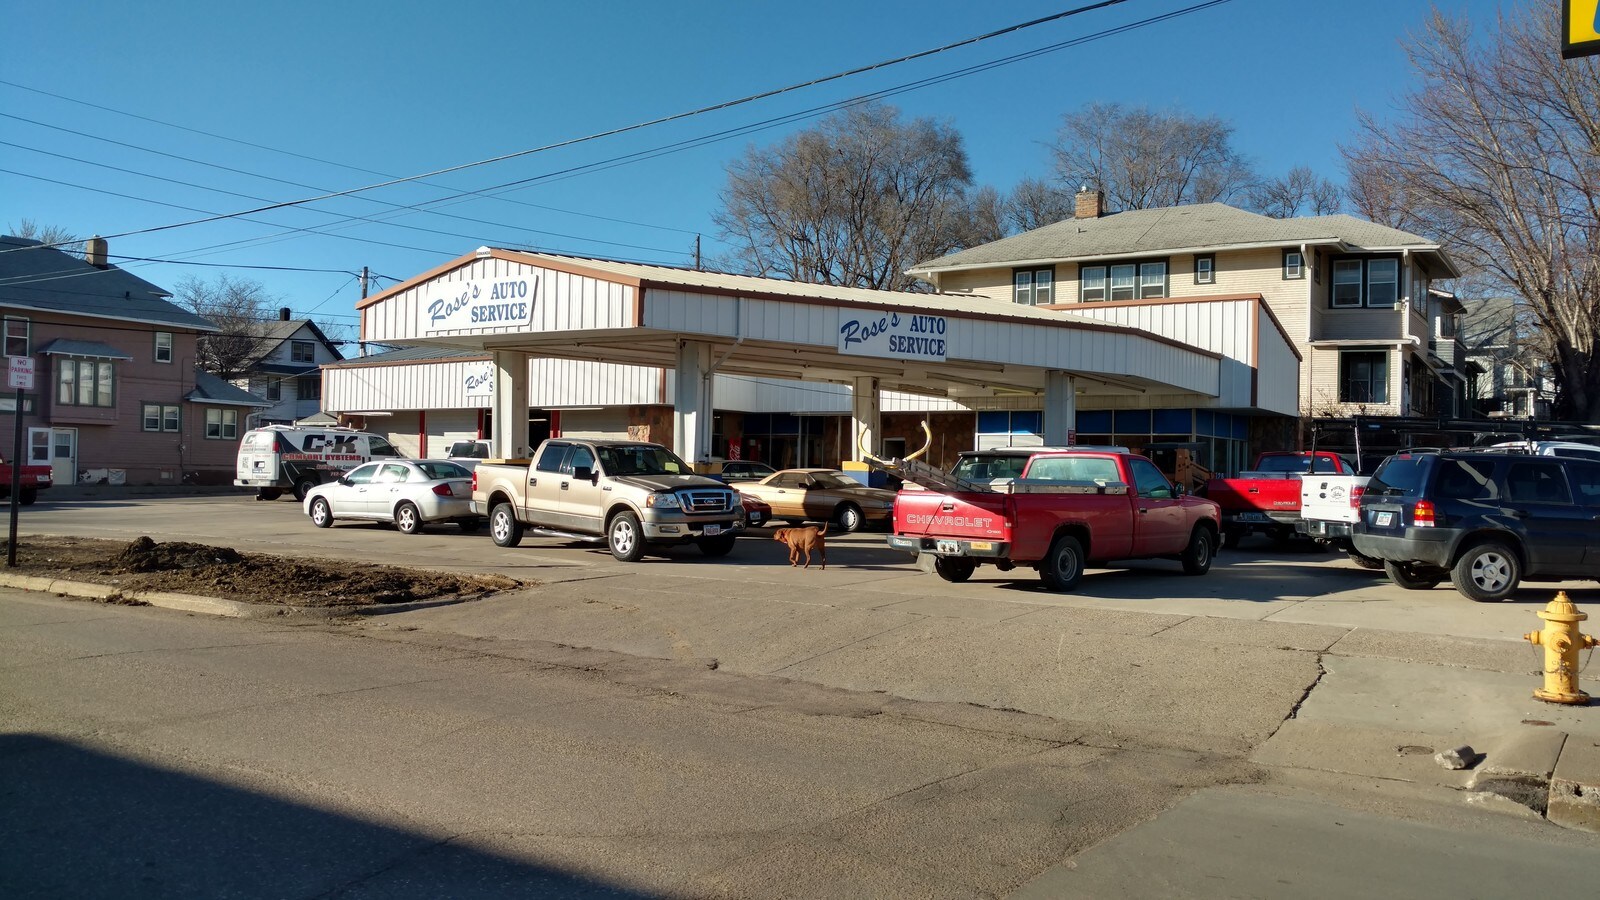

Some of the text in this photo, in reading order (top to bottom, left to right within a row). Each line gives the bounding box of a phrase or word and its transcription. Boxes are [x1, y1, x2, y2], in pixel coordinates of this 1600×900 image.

[427, 280, 527, 328] Rose's AUTO
[471, 302, 527, 323] SERVICE
[841, 310, 946, 350] Rose's AUTO
[889, 334, 946, 356] SERVICE
[11, 366, 33, 374] PARKING
[281, 452, 323, 461] COMFORT
[906, 513, 993, 528] CHEVROLET
